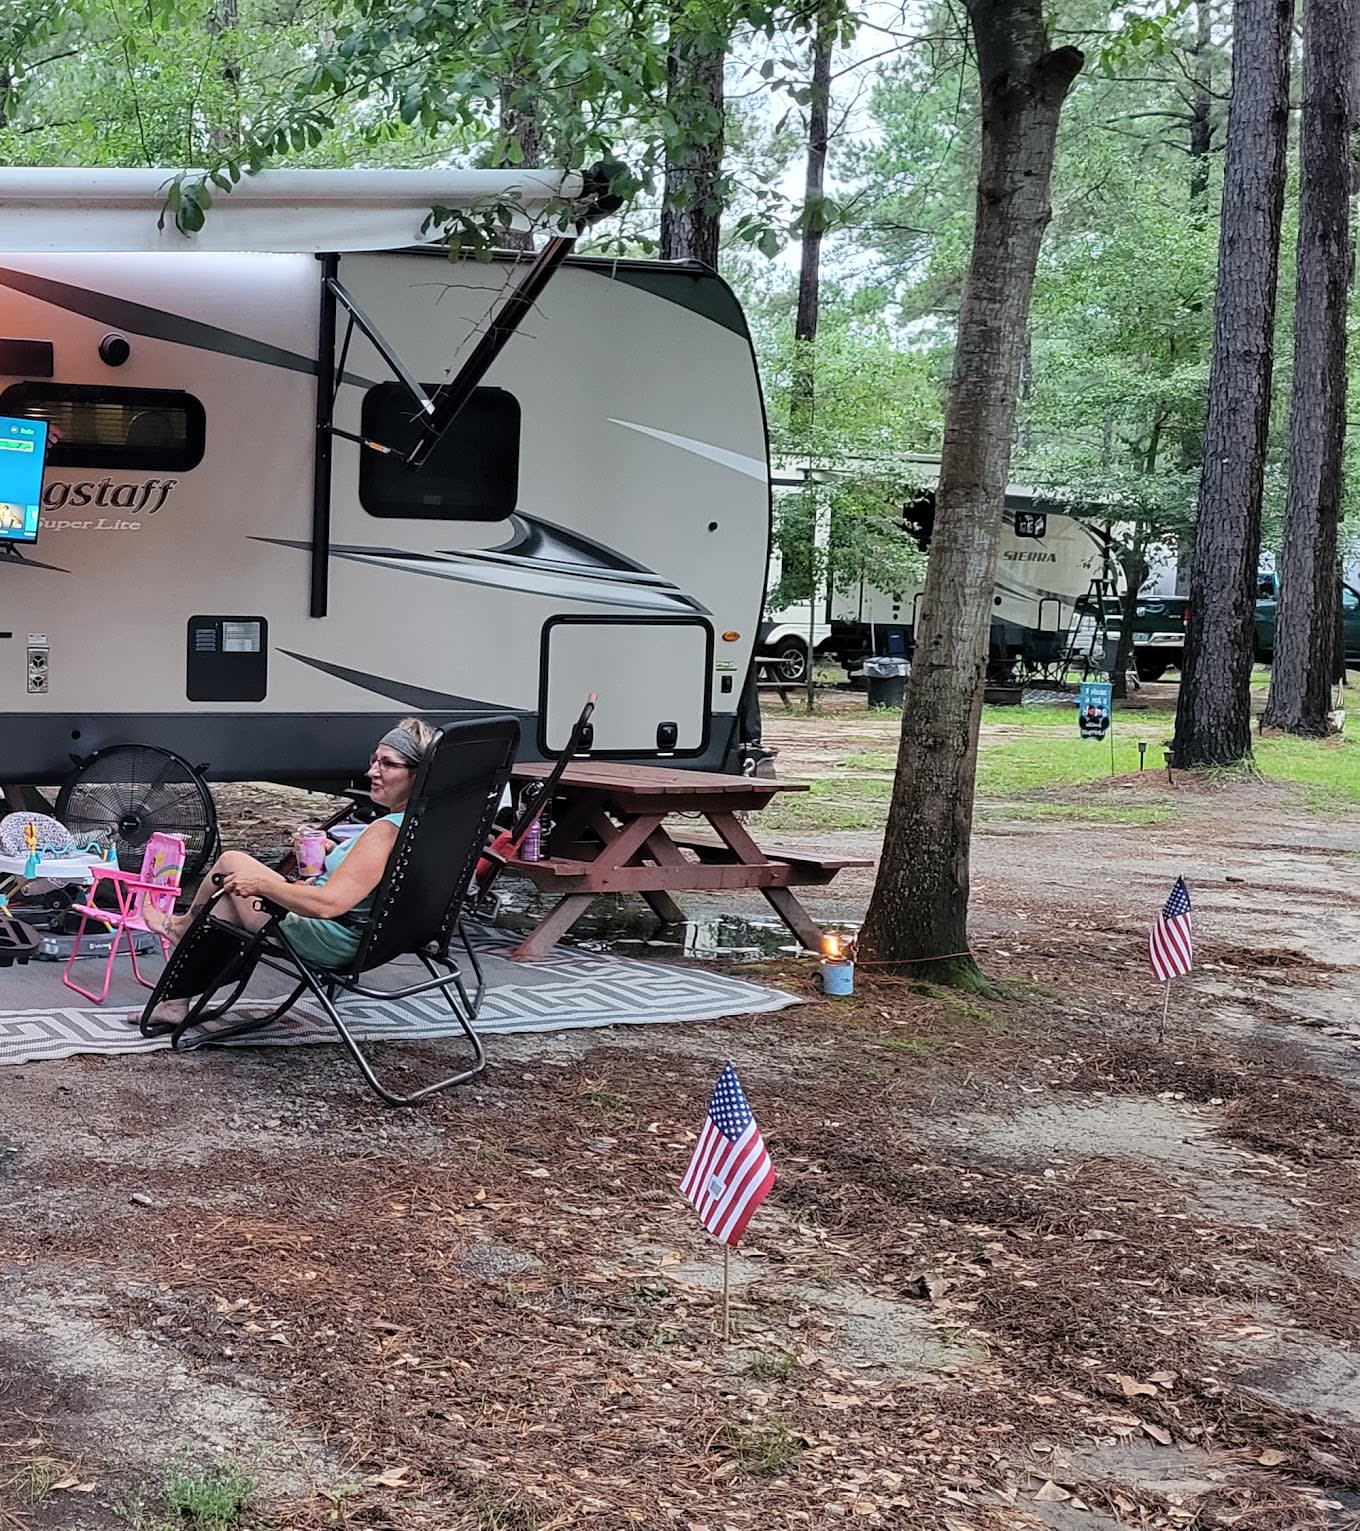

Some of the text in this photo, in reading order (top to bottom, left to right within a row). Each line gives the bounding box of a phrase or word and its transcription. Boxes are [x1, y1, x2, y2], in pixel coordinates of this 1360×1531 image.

[42, 477, 180, 515] gstaff
[39, 517, 142, 531] Super Lite
[1003, 550, 1057, 563] SIERRA
